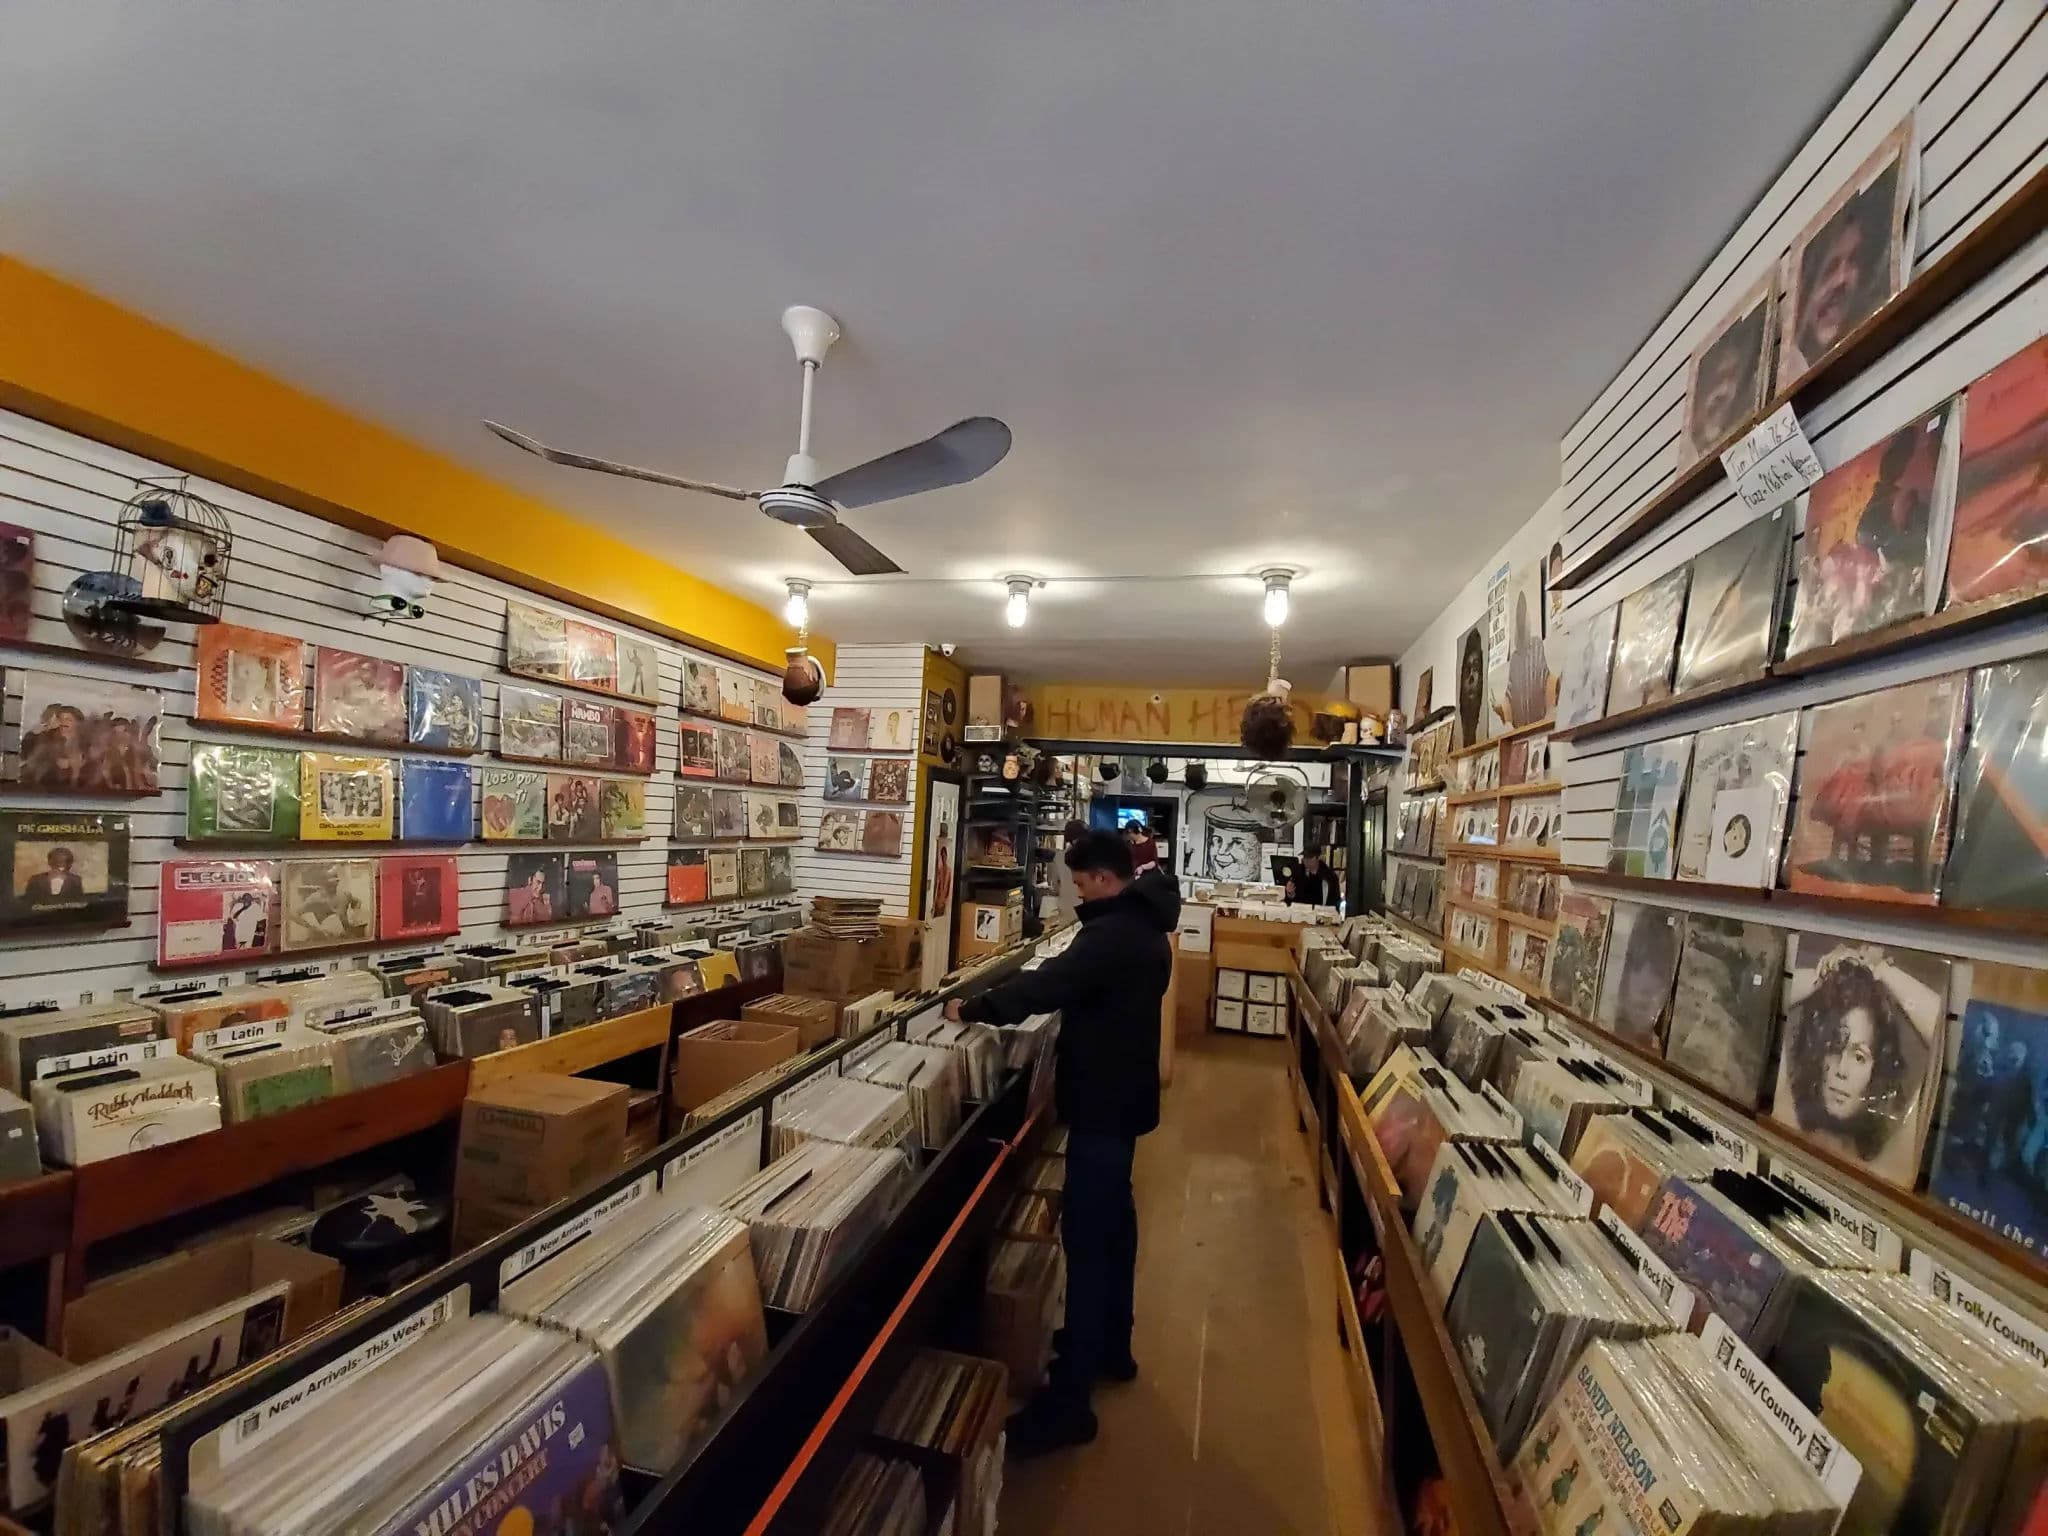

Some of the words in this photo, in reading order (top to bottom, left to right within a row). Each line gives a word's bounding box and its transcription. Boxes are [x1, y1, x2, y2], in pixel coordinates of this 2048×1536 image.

[1047, 698, 1171, 736] HUMAN
[293, 963, 320, 976] Latin
[174, 980, 207, 992] Latin
[358, 1004, 378, 1015] Latin
[231, 1024, 264, 1042] Latin
[88, 1050, 129, 1068] Latin
[1715, 1133, 1734, 1151] Rock
[539, 1237, 560, 1253] New
[593, 1203, 608, 1221] This
[609, 1192, 630, 1212] Week
[1833, 1206, 1860, 1235] Rock
[1642, 1259, 1662, 1286] Rock
[1956, 1291, 2048, 1368] Folk/Country
[268, 1391, 304, 1419] New
[306, 1358, 363, 1398] Arrivals-
[364, 1338, 391, 1361] This
[391, 1316, 427, 1343] Week
[1733, 1356, 1808, 1446] Folk/Country
[1576, 1364, 1614, 1420] SANDY
[1606, 1414, 1658, 1494] NELSON
[415, 1459, 500, 1536] MILES
[500, 1401, 567, 1478] DAVIS
